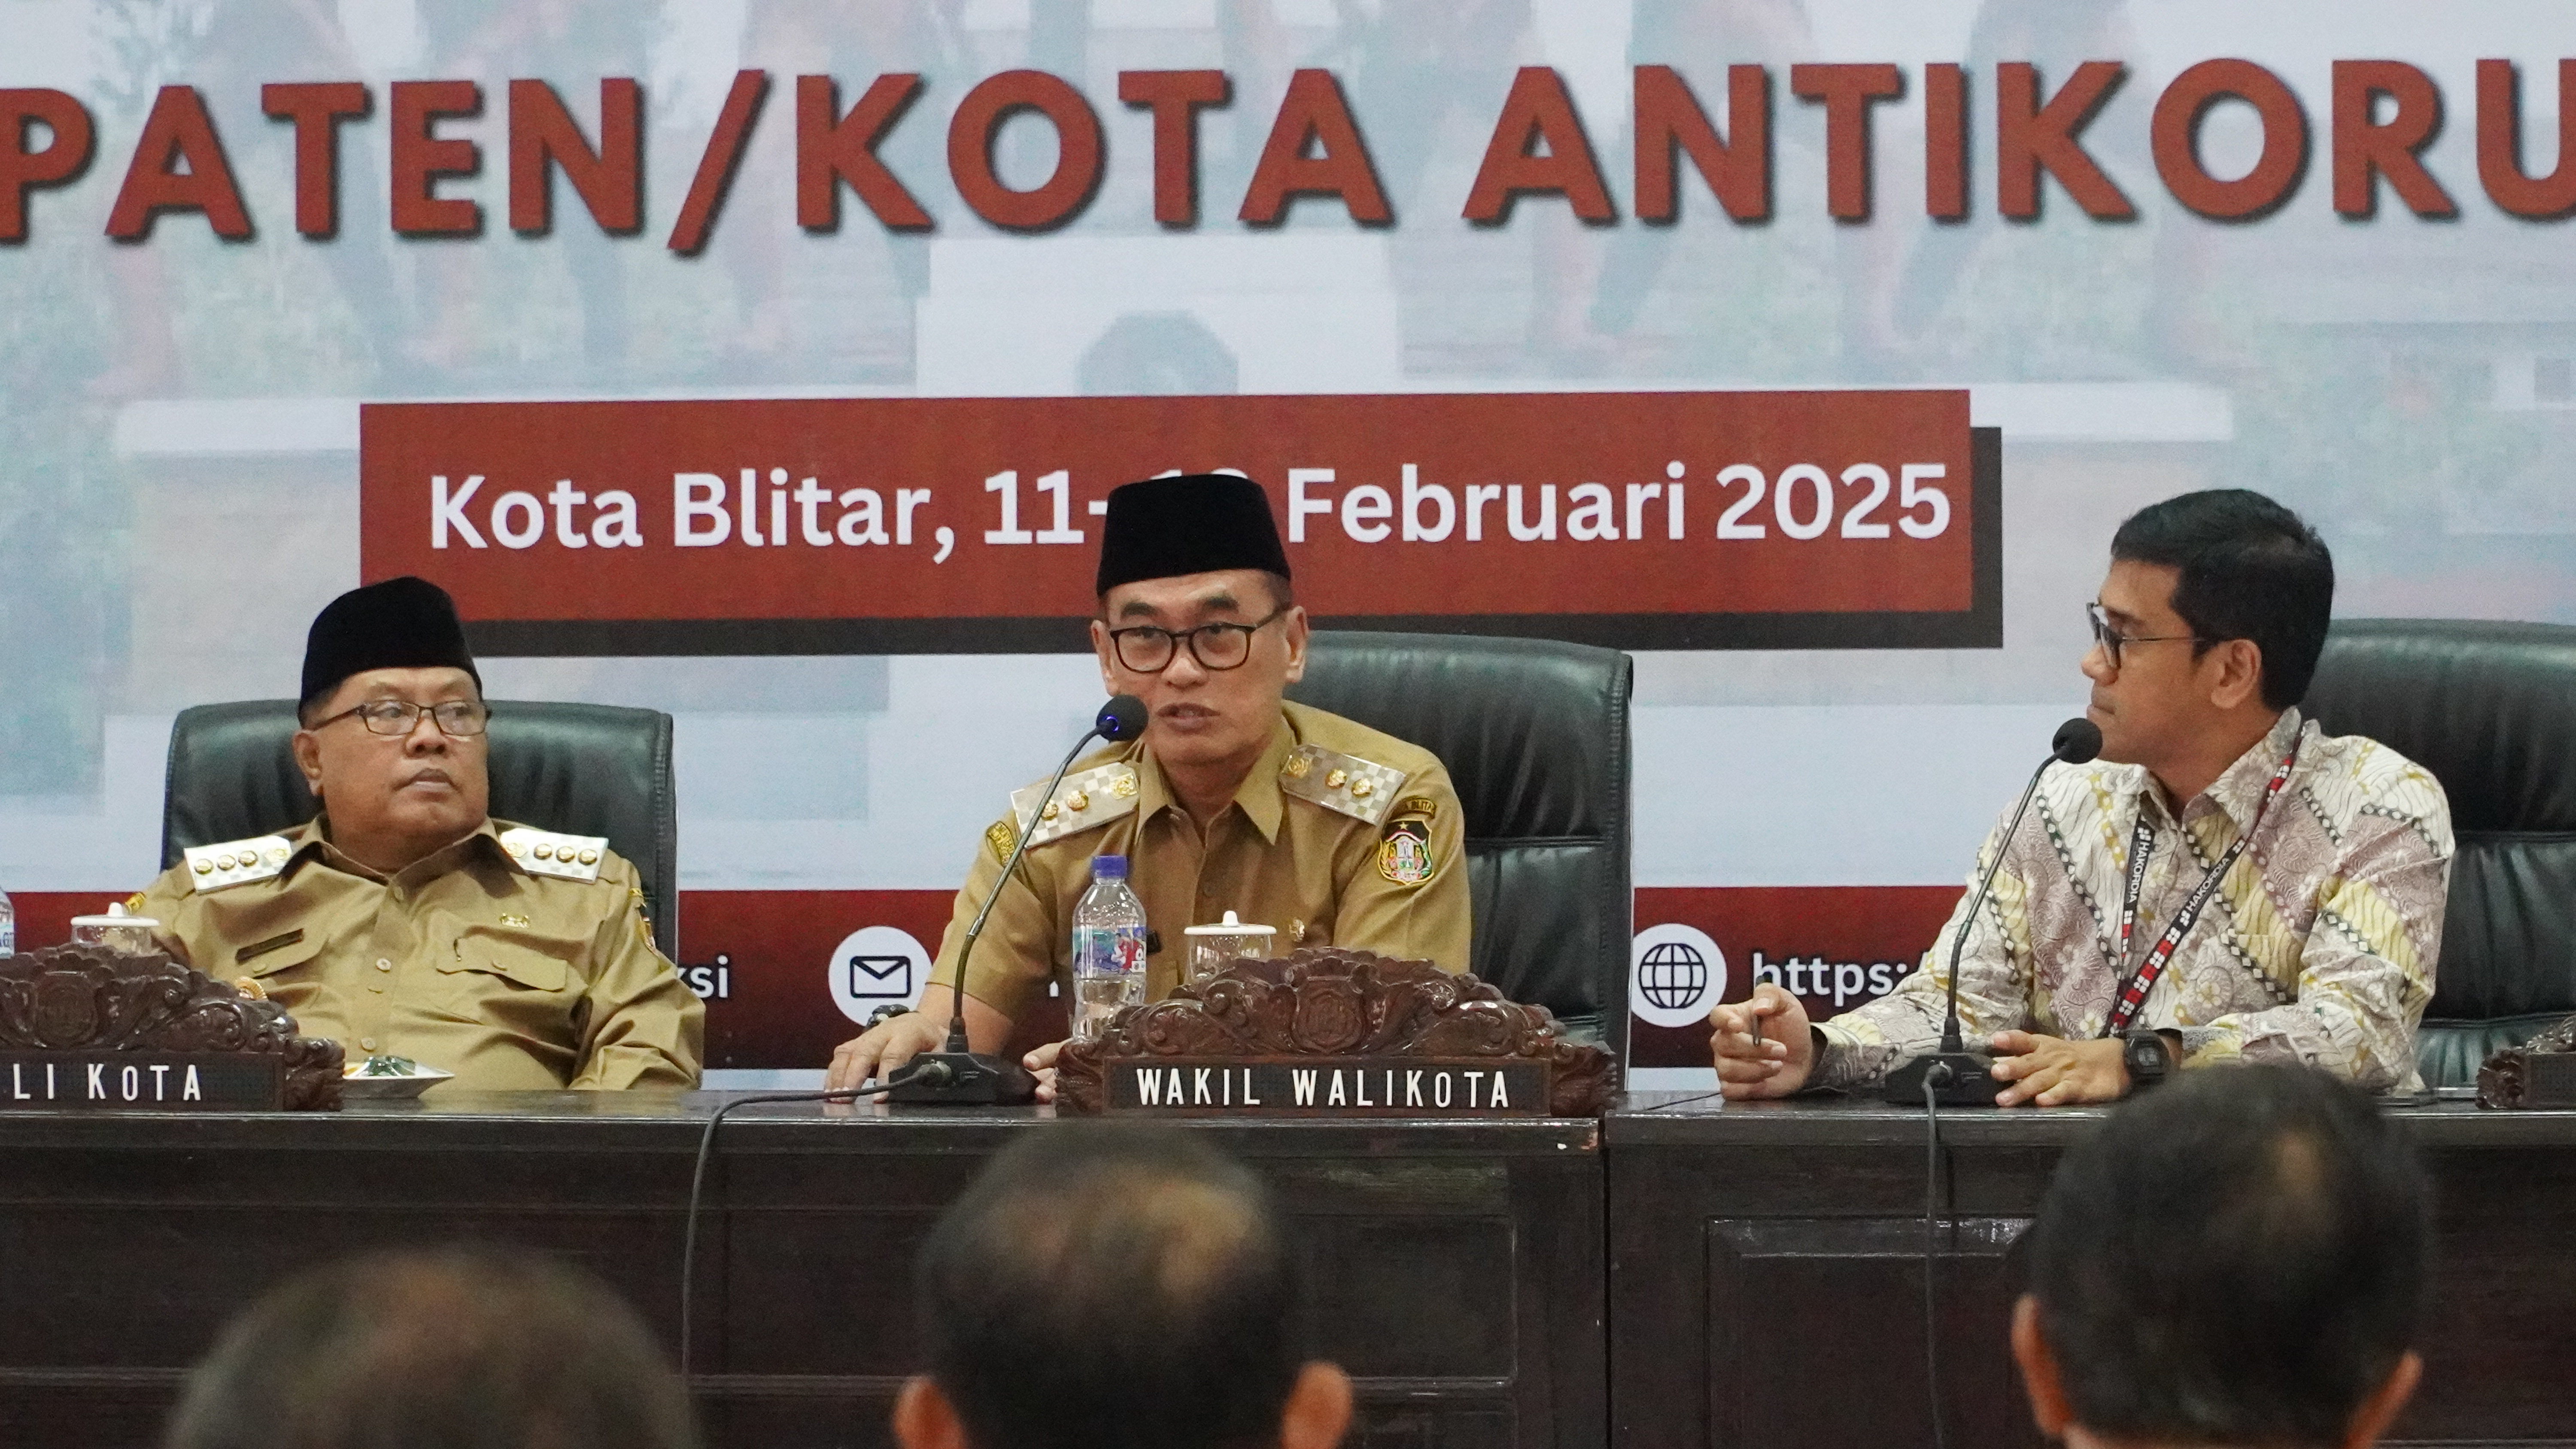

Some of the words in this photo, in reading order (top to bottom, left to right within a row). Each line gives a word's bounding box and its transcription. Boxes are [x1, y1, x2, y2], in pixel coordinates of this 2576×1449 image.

[0, 70, 1391, 250] PATEN/KOTA
[1462, 59, 2576, 219] ANTIKORU
[431, 474, 644, 549] Kota
[674, 467, 955, 564] Blitar,
[1288, 461, 1686, 543] Februari
[1716, 463, 1951, 540] 2025
[88, 1063, 201, 1101] KOTA
[1136, 1068, 1261, 1106] WAKIL
[1292, 1069, 1509, 1108] WALIKOTA
